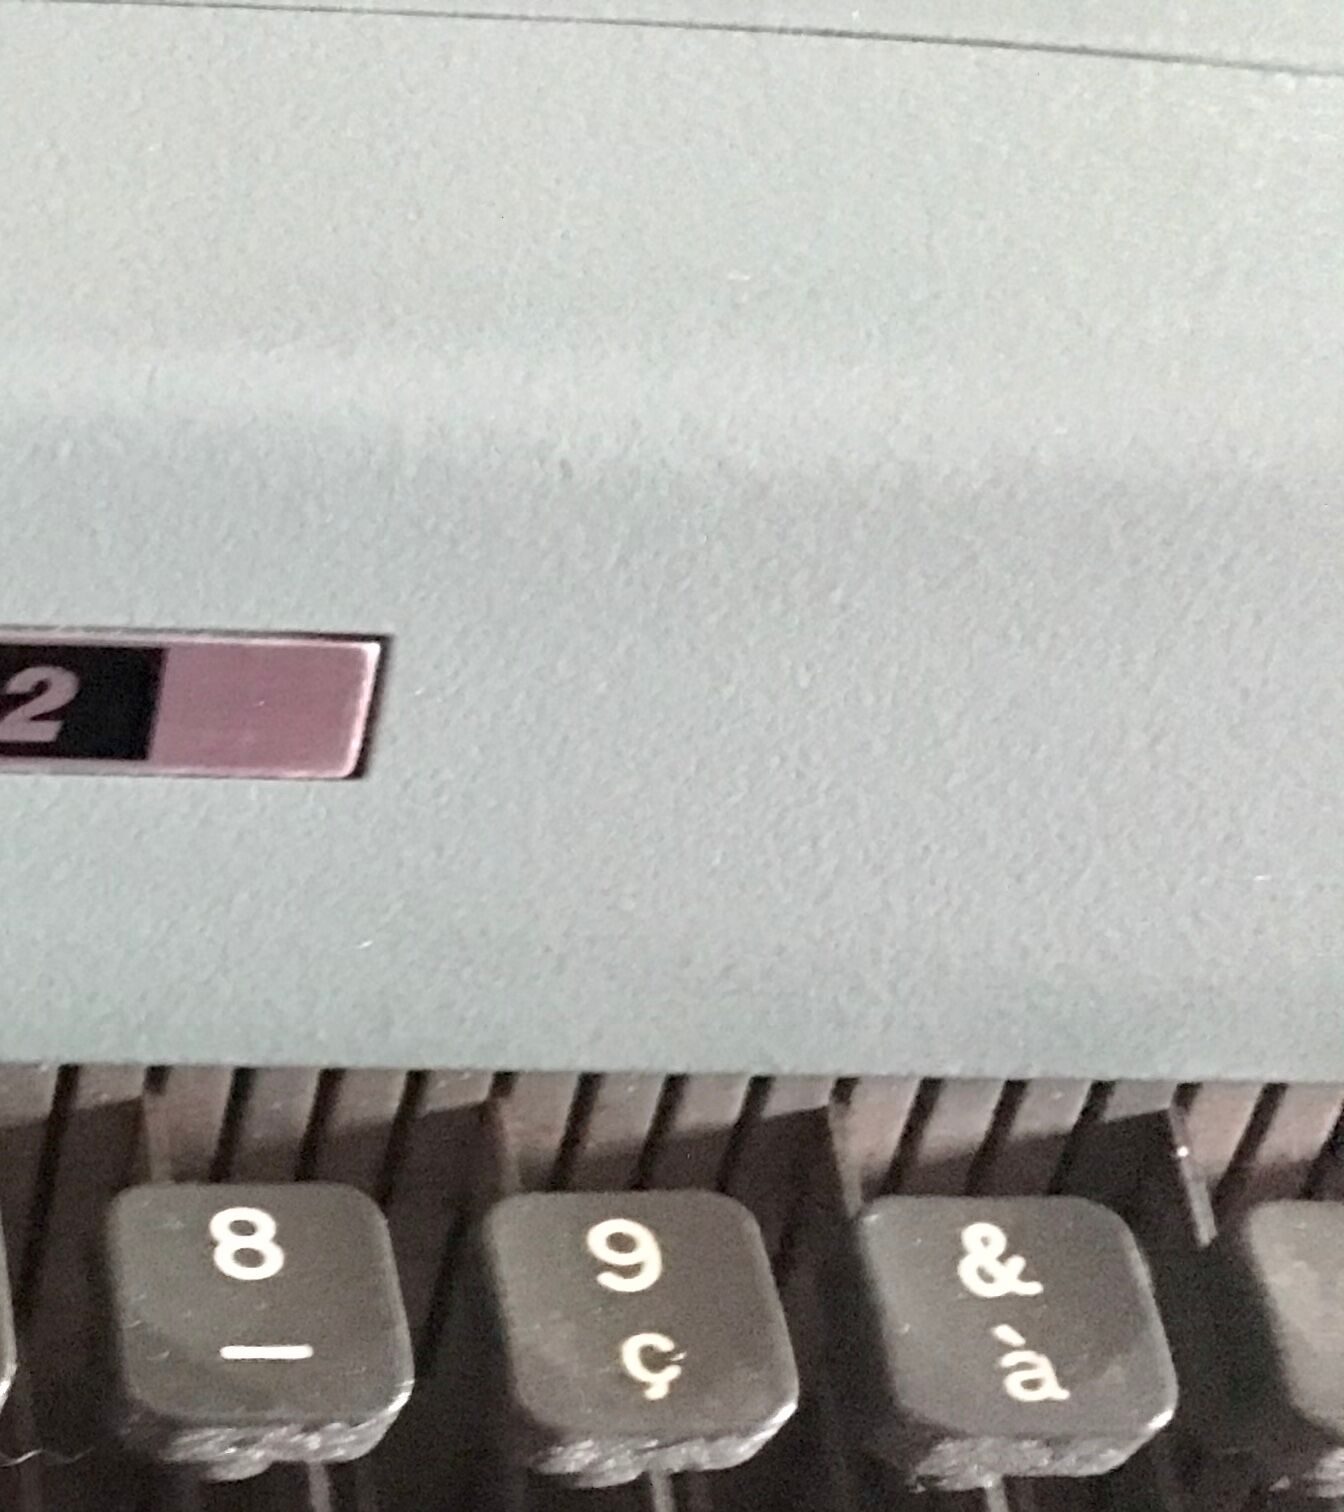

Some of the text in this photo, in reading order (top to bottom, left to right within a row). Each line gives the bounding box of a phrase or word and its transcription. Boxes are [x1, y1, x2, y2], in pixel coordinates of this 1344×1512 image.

[208, 1205, 286, 1282] 8
[586, 1217, 663, 1294] 9
[956, 1221, 1045, 1299] &
[620, 1331, 682, 1401] ç
[992, 1323, 1072, 1403] à
